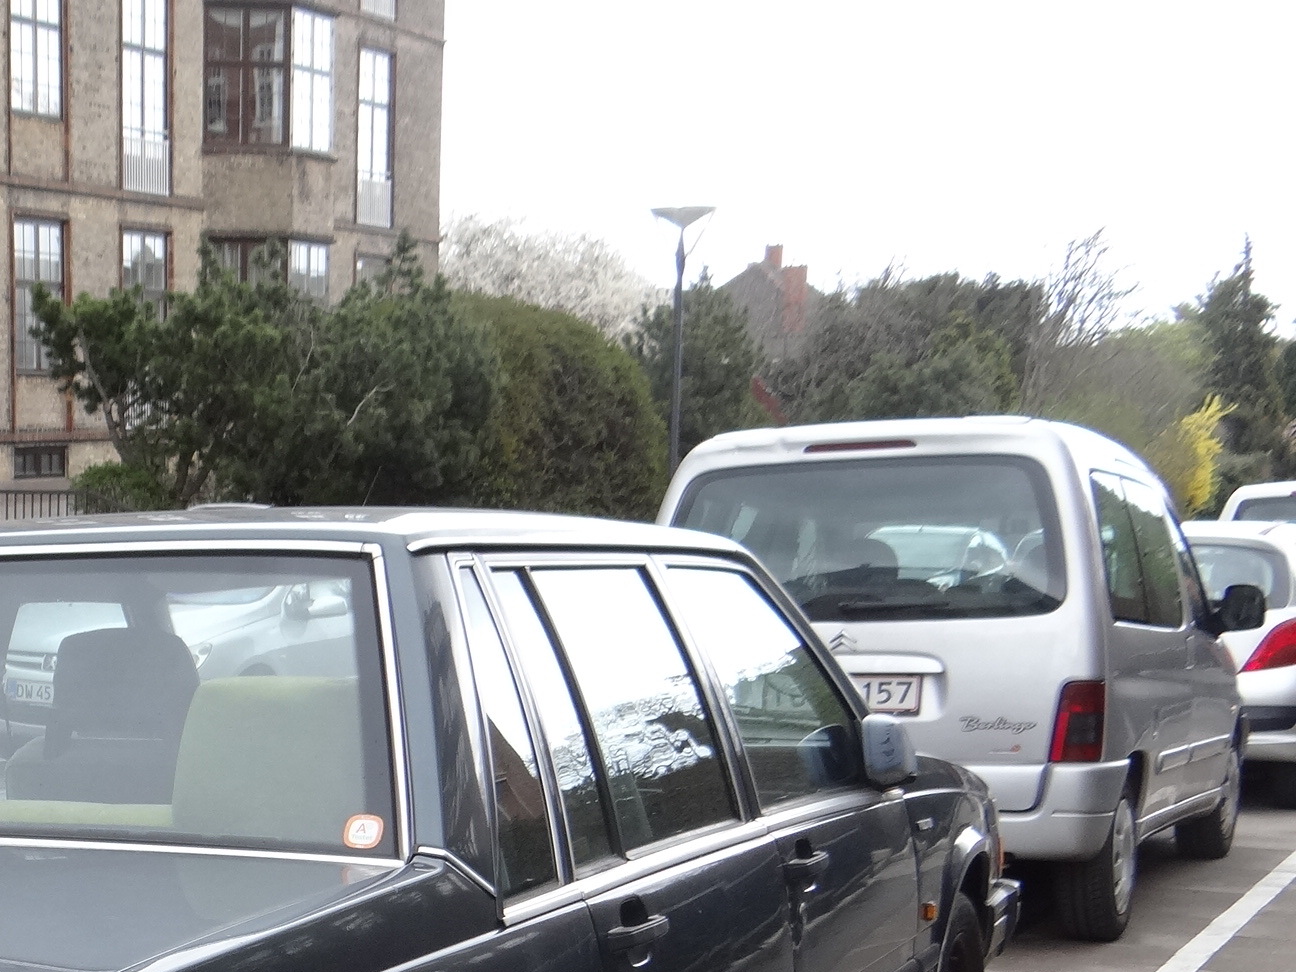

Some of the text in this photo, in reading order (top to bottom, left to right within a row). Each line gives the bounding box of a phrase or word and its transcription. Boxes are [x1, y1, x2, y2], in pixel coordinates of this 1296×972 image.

[16, 683, 34, 699] DW
[862, 681, 913, 705] 157
[355, 822, 366, 834] A
